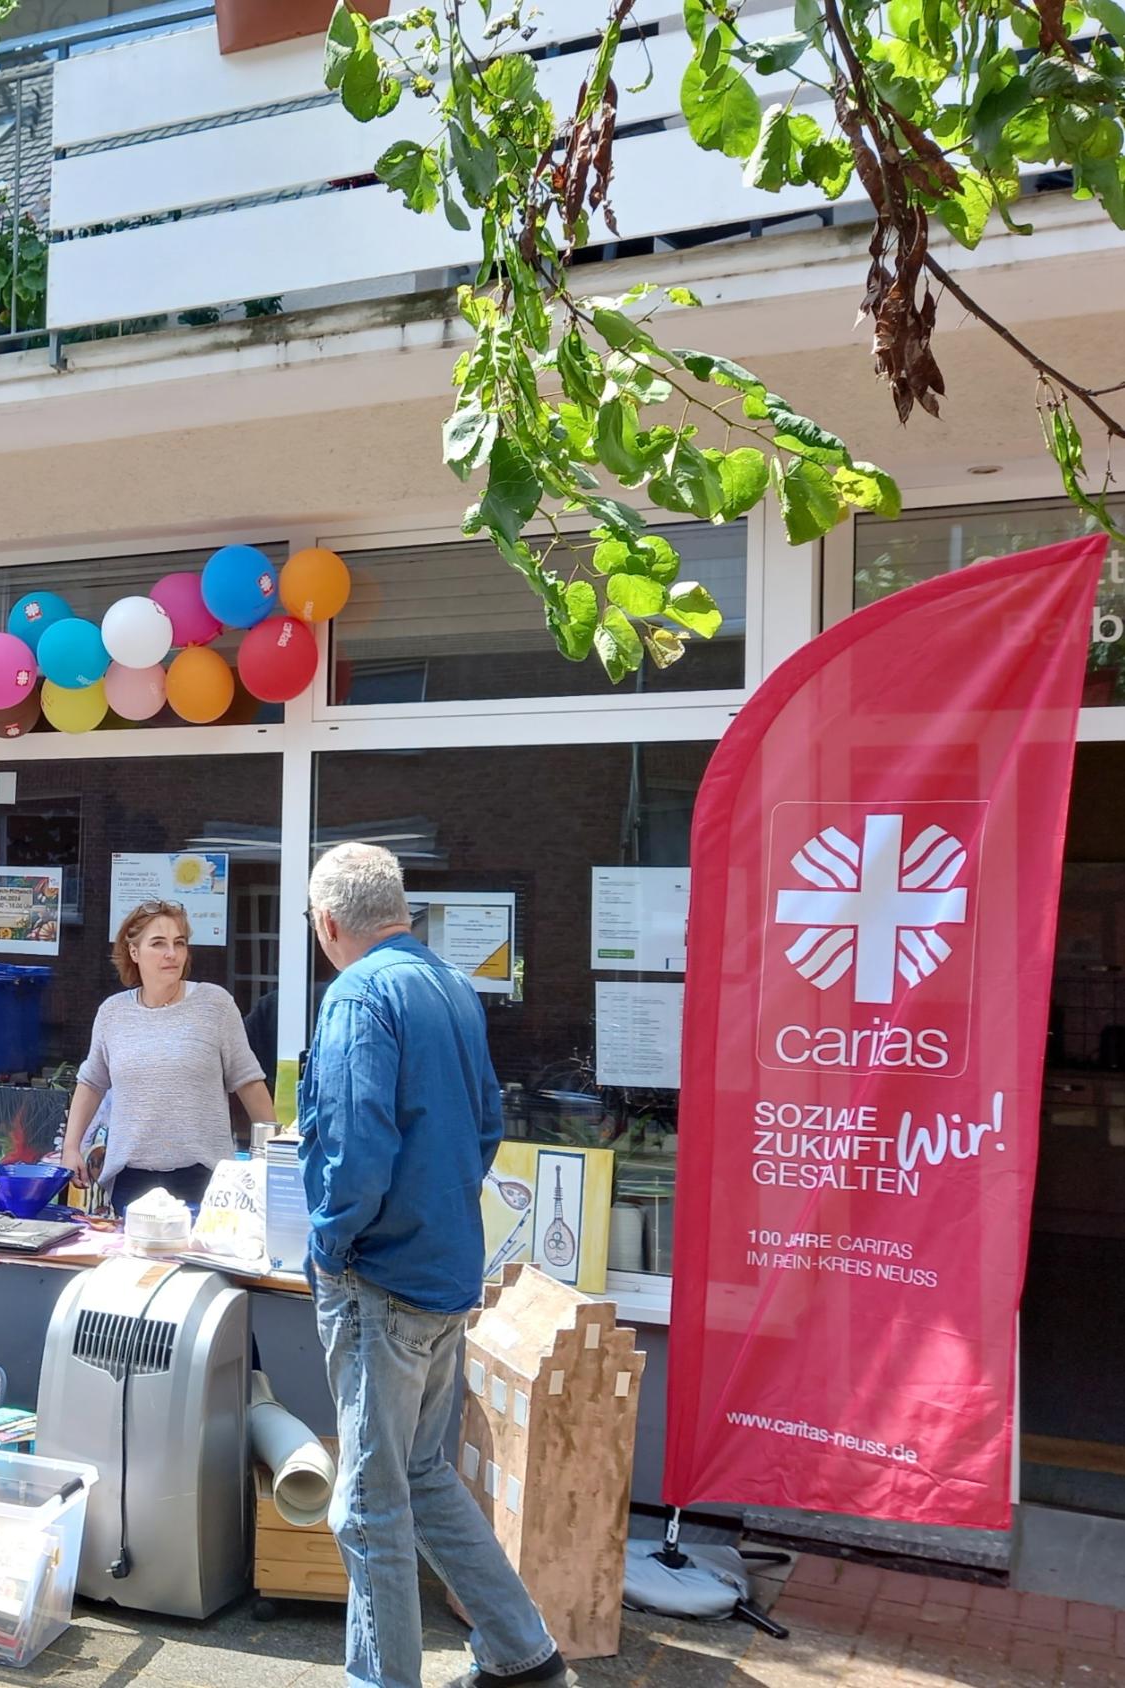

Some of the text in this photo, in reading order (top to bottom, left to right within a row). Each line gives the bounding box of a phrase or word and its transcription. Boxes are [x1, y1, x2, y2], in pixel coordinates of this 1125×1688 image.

[776, 1017, 949, 1069] caritas
[754, 1101, 878, 1132] SOZIALE
[897, 1091, 1006, 1171] Wir!
[752, 1130, 895, 1162] ZUKUNFT
[747, 1229, 781, 1247] 100
[837, 1234, 914, 1260] CARITAS
[746, 1250, 768, 1267] IM
[876, 1263, 938, 1288] NEUSS
[726, 1411, 918, 1464] www.caritas-neuss.de
